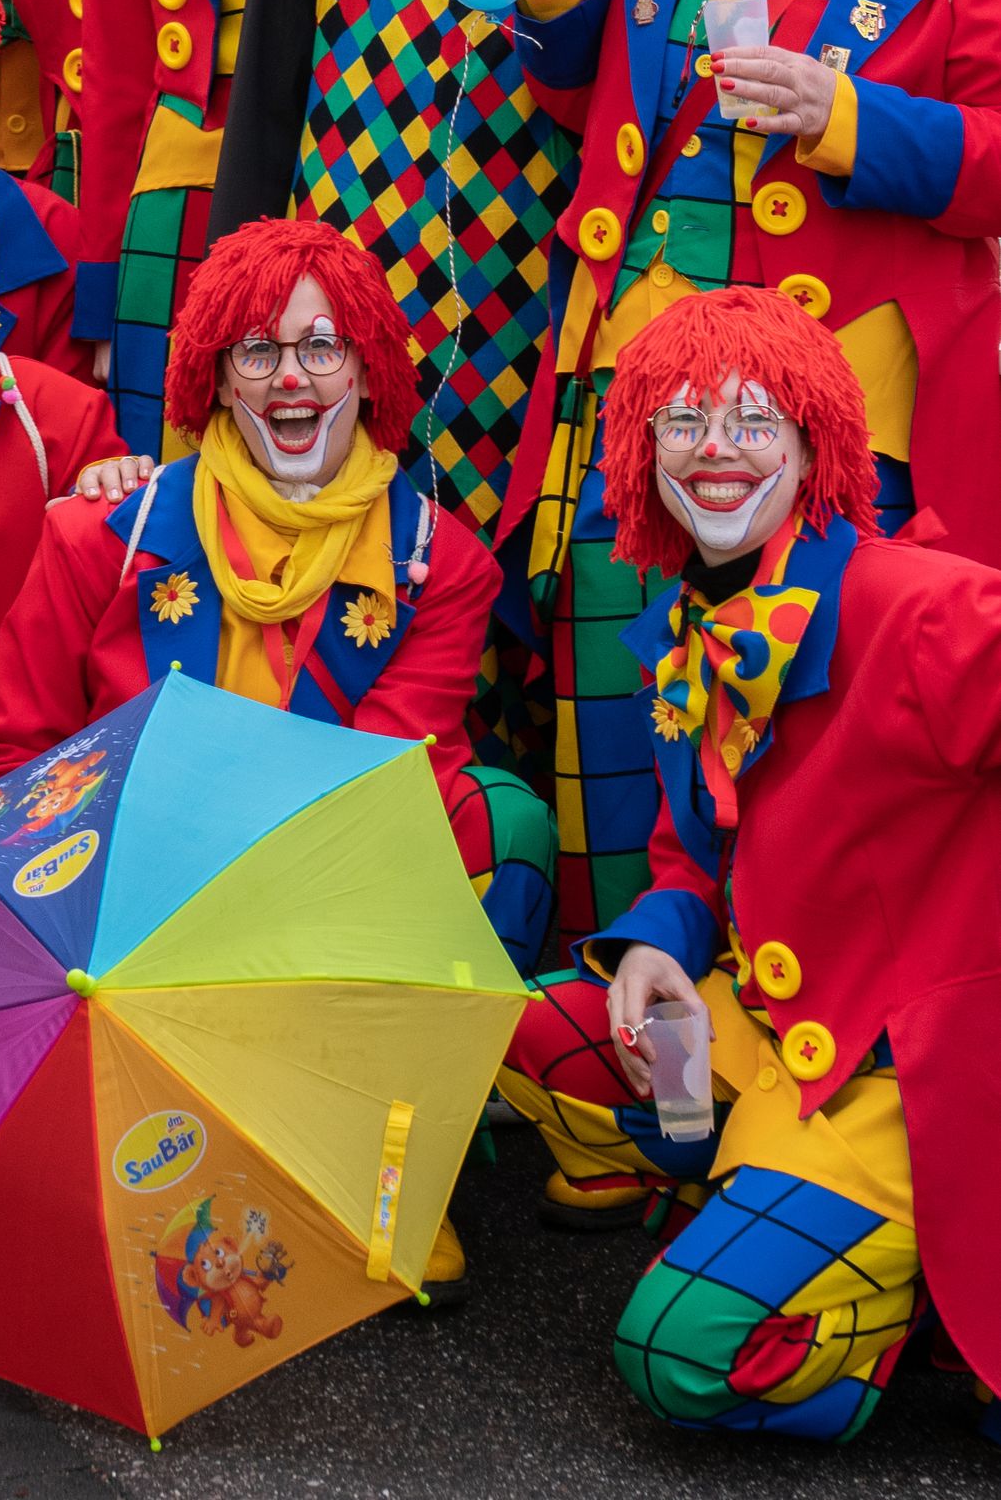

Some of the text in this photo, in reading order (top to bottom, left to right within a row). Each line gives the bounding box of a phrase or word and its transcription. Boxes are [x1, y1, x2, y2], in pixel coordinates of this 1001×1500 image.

[20, 834, 91, 884] SauBär
[166, 1115, 184, 1129] dm
[124, 1129, 197, 1185] SauBär
